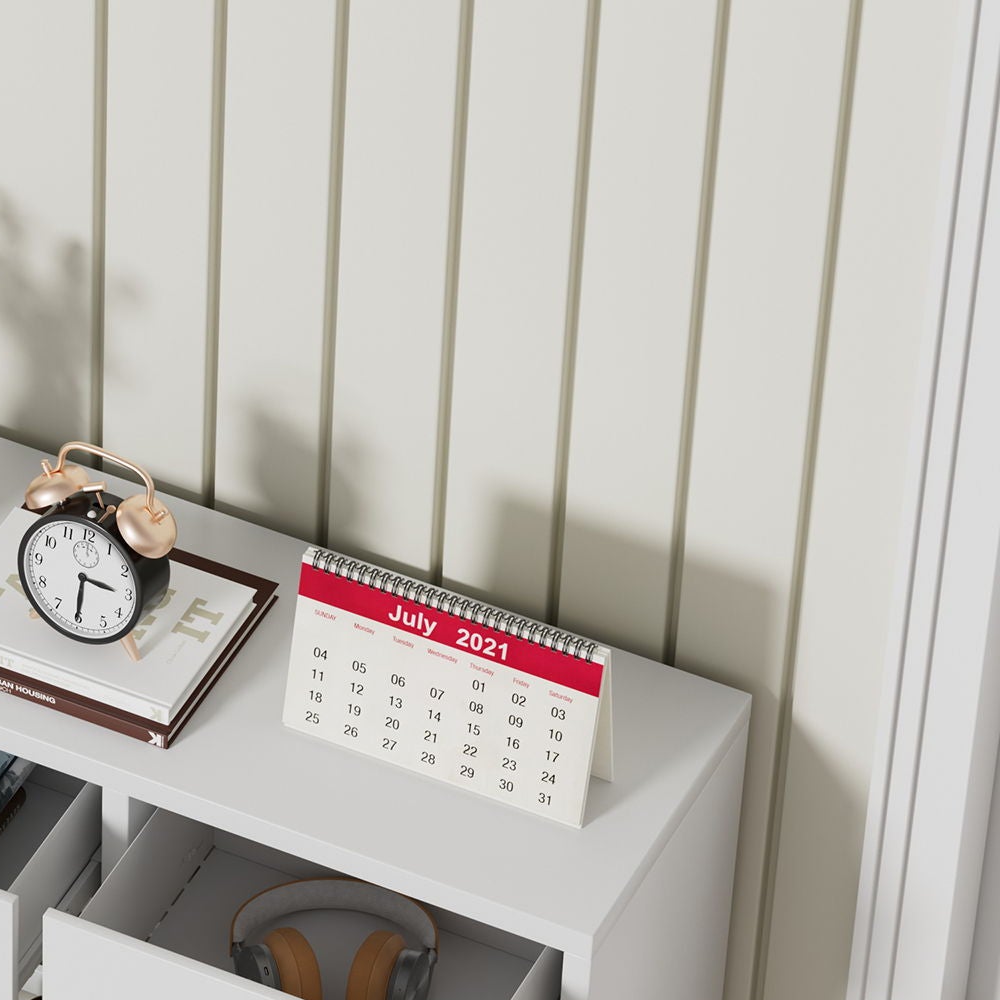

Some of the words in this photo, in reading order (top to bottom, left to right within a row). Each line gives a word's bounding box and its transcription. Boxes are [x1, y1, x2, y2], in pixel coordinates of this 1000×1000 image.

[63, 526, 73, 540] 11
[83, 529, 96, 543] 12
[45, 535, 57, 549] 10
[107, 543, 112, 556] 1
[34, 552, 43, 565] 9
[120, 564, 129, 578] 2
[38, 576, 47, 588] 8
[125, 588, 133, 601] 3
[54, 597, 62, 609] 7
[114, 607, 122, 618] 4
[100, 615, 107, 628] 5
[388, 604, 438, 637] July
[455, 628, 508, 660] 2021
[0, 655, 14, 668] IT
[354, 622, 375, 636] Monday
[392, 636, 414, 649] Tuesday
[427, 648, 458, 664] Wednesday
[470, 662, 495, 677] Thursday
[512, 677, 530, 689] Friday
[548, 690, 573, 704] Saturday
[16, 685, 56, 704] HOUSING
[313, 646, 328, 661] 04
[351, 660, 367, 674] 05
[390, 673, 406, 688] 06
[429, 687, 445, 701] 07
[468, 700, 484, 715] 08
[508, 714, 524, 729] 09
[548, 728, 563, 742] 10
[471, 679, 486, 693] 01
[511, 692, 527, 708] 02
[550, 706, 566, 721] 03
[311, 668, 324, 682] 11
[350, 682, 364, 696] 12
[389, 695, 403, 709] 13
[428, 709, 441, 723] 14
[467, 722, 481, 736] 15
[506, 736, 520, 750] 16
[545, 750, 560, 763] 17
[309, 689, 323, 704] 18
[347, 703, 362, 717] 19
[384, 716, 400, 731] 20
[423, 729, 437, 744] 21
[462, 743, 478, 758] 22
[501, 757, 517, 772] 23
[540, 770, 556, 785] 24
[305, 710, 320, 725] 25
[343, 724, 359, 738] 26
[382, 737, 398, 751] 27
[420, 751, 436, 765] 28
[459, 764, 475, 779] 29
[498, 778, 514, 793] 30
[537, 792, 552, 806] 31
